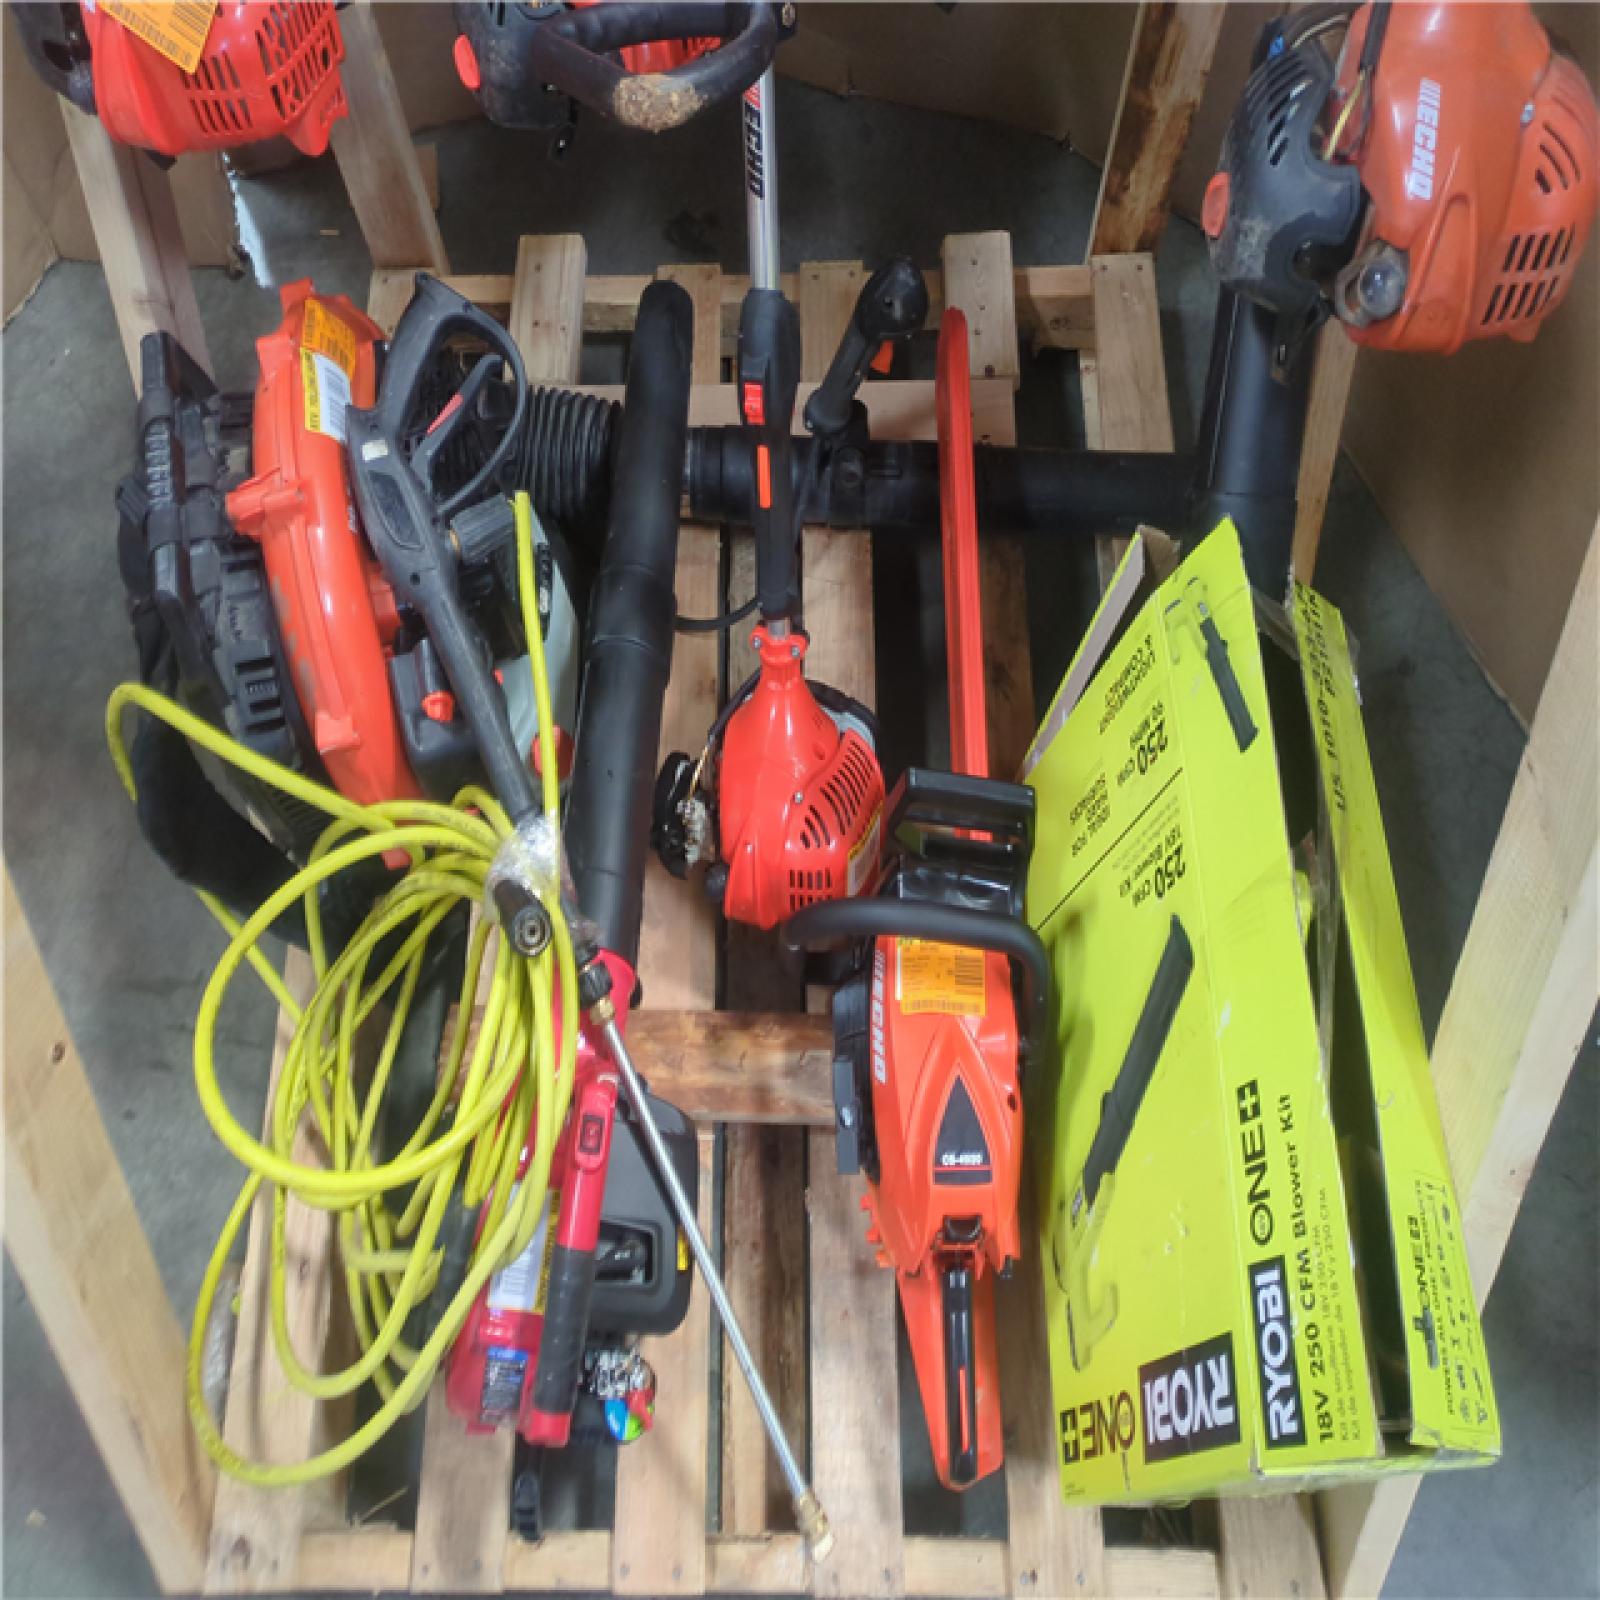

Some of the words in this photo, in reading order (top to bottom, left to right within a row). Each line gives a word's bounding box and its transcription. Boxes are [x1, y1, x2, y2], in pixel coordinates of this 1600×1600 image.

[744, 102, 765, 199] ECHO
[1405, 104, 1440, 200] ECHO
[1137, 718, 1168, 776] 250
[1154, 842, 1185, 898] 250
[872, 980, 887, 1084] ECHO
[1278, 1094, 1294, 1133] Kit
[1286, 1141, 1307, 1239] Blower
[1297, 1247, 1316, 1311] CFM
[1254, 1265, 1299, 1441] RYOBI
[1304, 1321, 1326, 1378] 250
[1143, 1353, 1236, 1444] RYOBI
[1313, 1388, 1335, 1443] 18V
